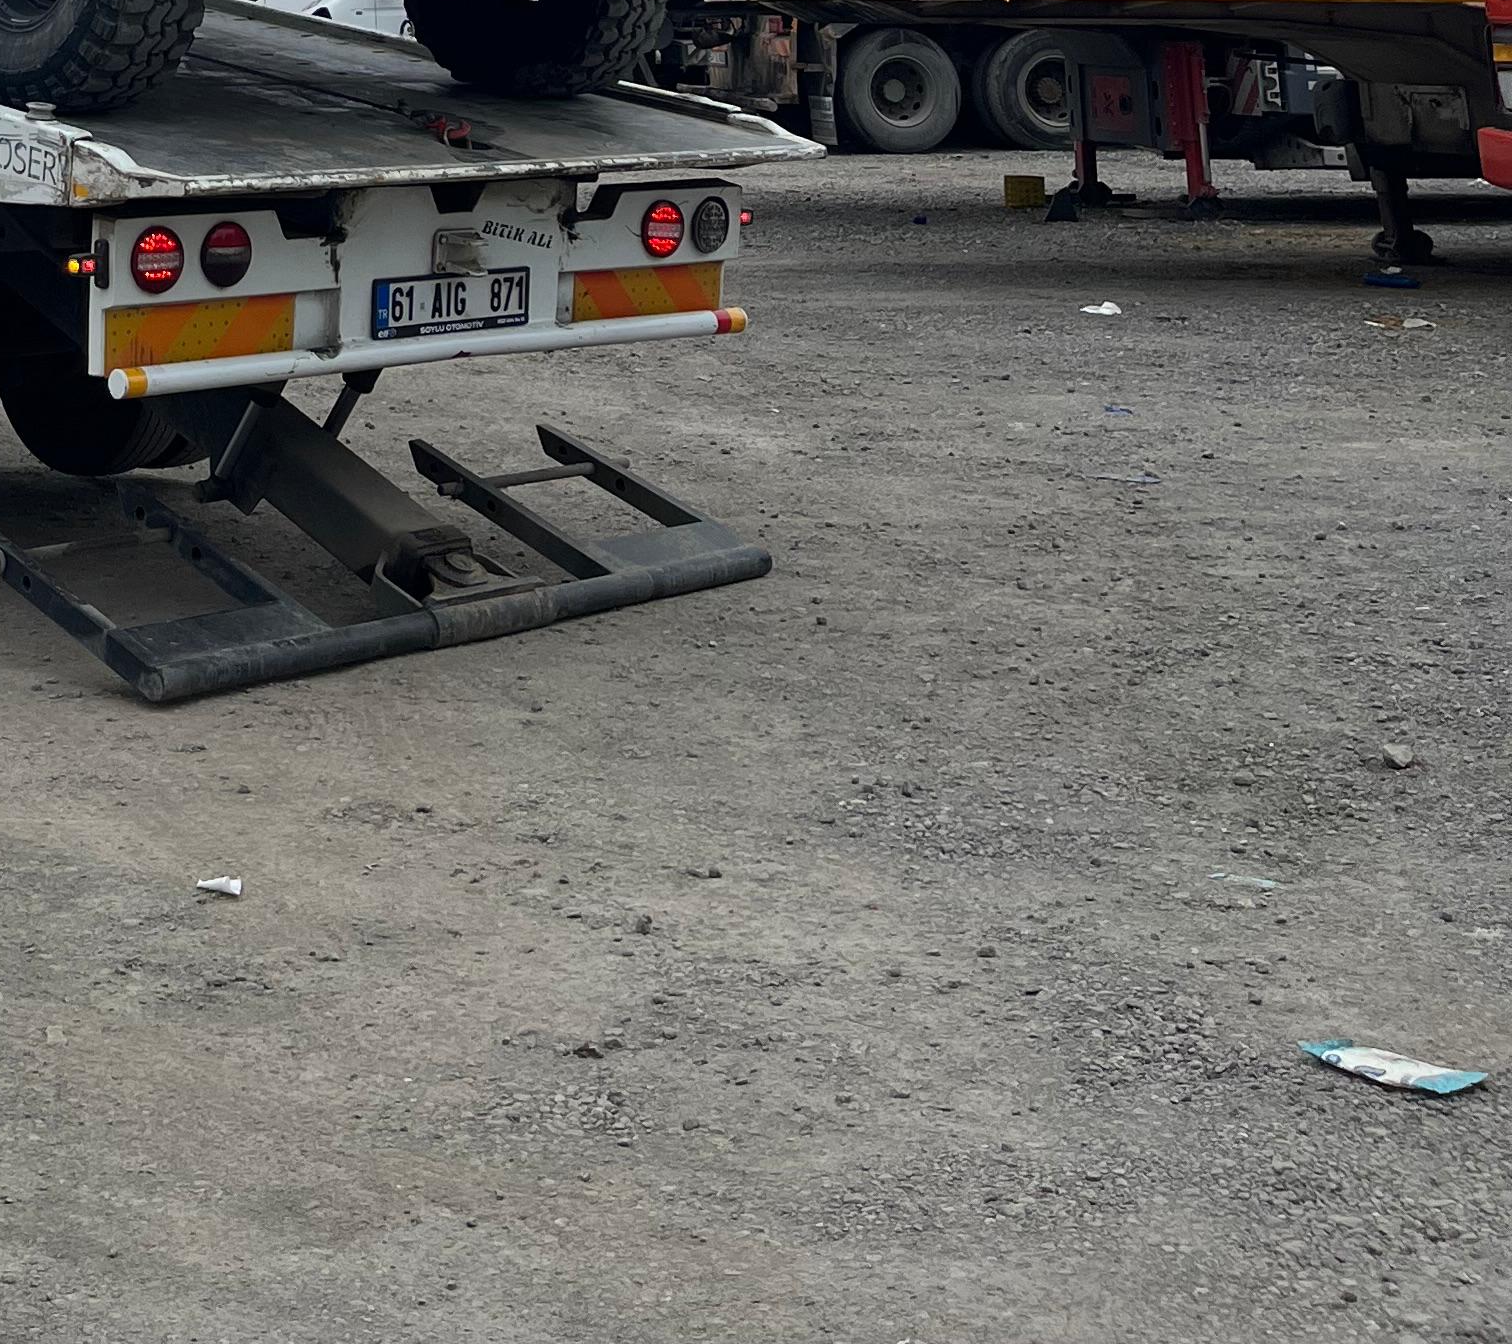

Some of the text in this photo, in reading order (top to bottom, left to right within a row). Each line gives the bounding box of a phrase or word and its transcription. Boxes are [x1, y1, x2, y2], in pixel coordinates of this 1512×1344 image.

[377, 275, 524, 322] TR 61 AIG 871
